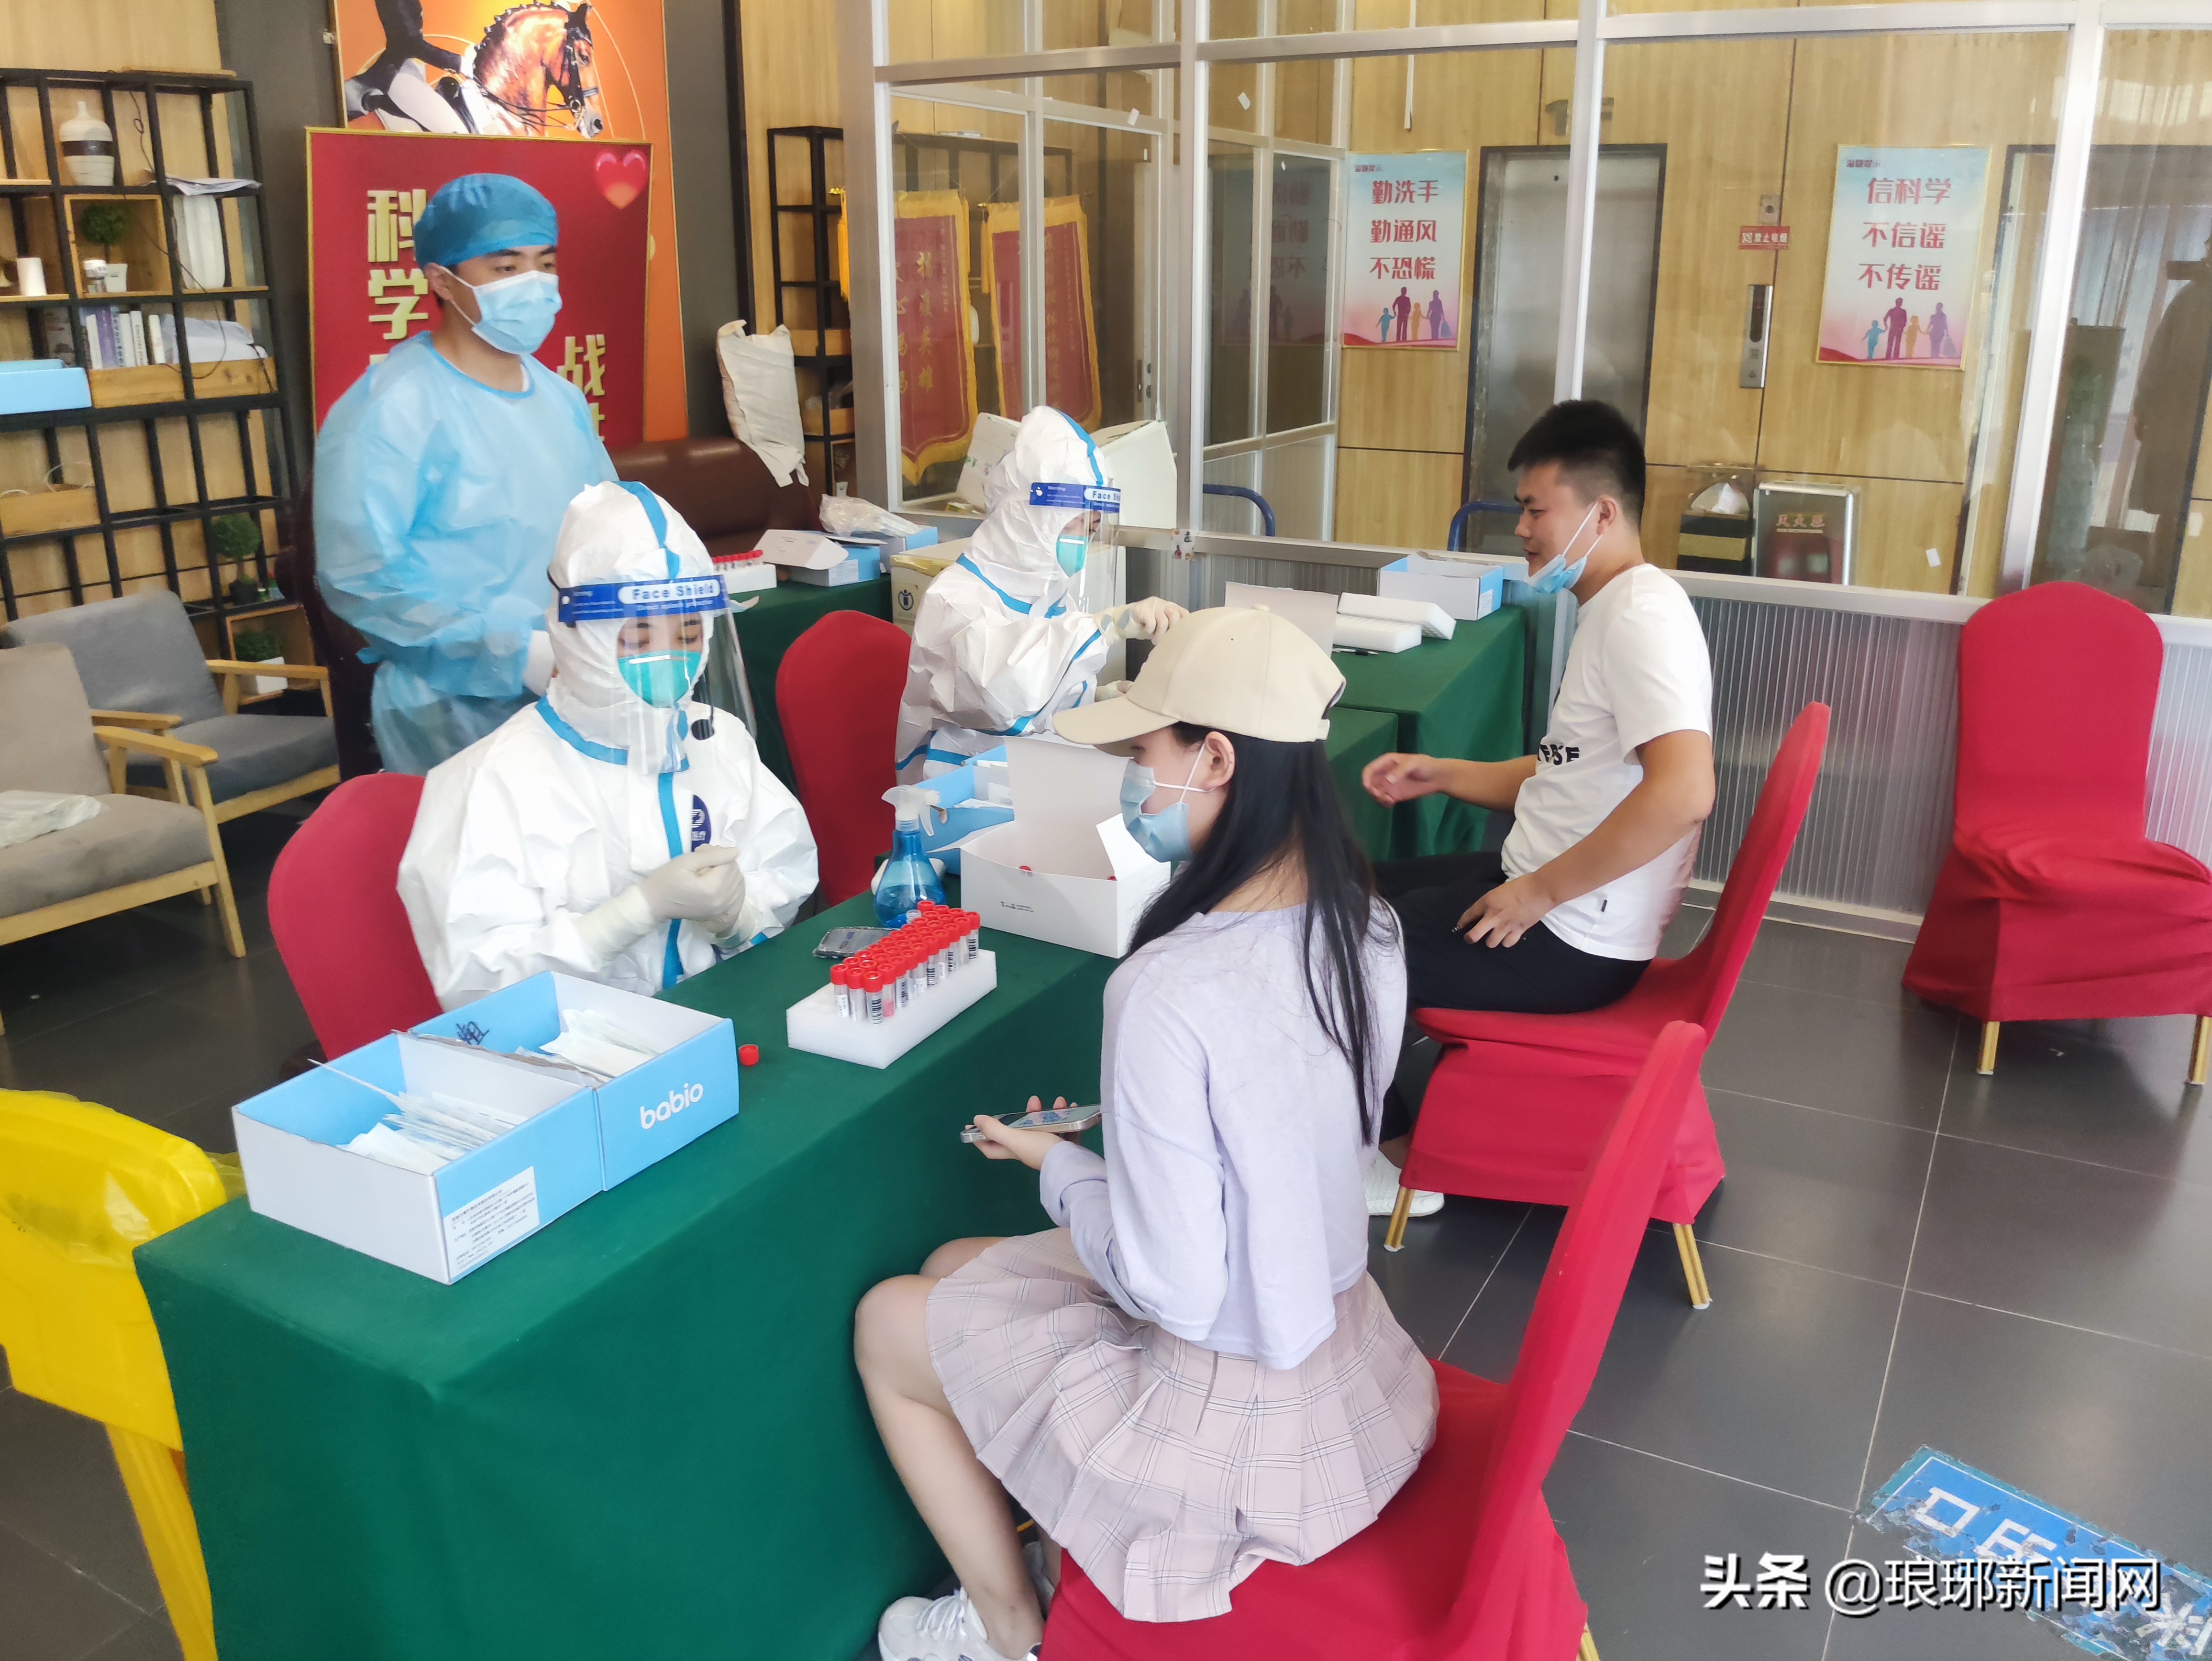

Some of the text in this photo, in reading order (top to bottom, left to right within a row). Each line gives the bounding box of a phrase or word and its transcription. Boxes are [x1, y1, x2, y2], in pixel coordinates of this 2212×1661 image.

[1371, 179, 1439, 204] 勤洗手
[1867, 177, 1952, 205] 信科学
[1370, 219, 1438, 244] 勤通风
[1861, 221, 1947, 249] 不信谣
[1369, 256, 1436, 280] 不恐慌
[1857, 263, 1943, 291] 不传谣
[1093, 491, 1111, 500] Face
[633, 583, 714, 600] Face Shield
[640, 1082, 704, 1129] babio
